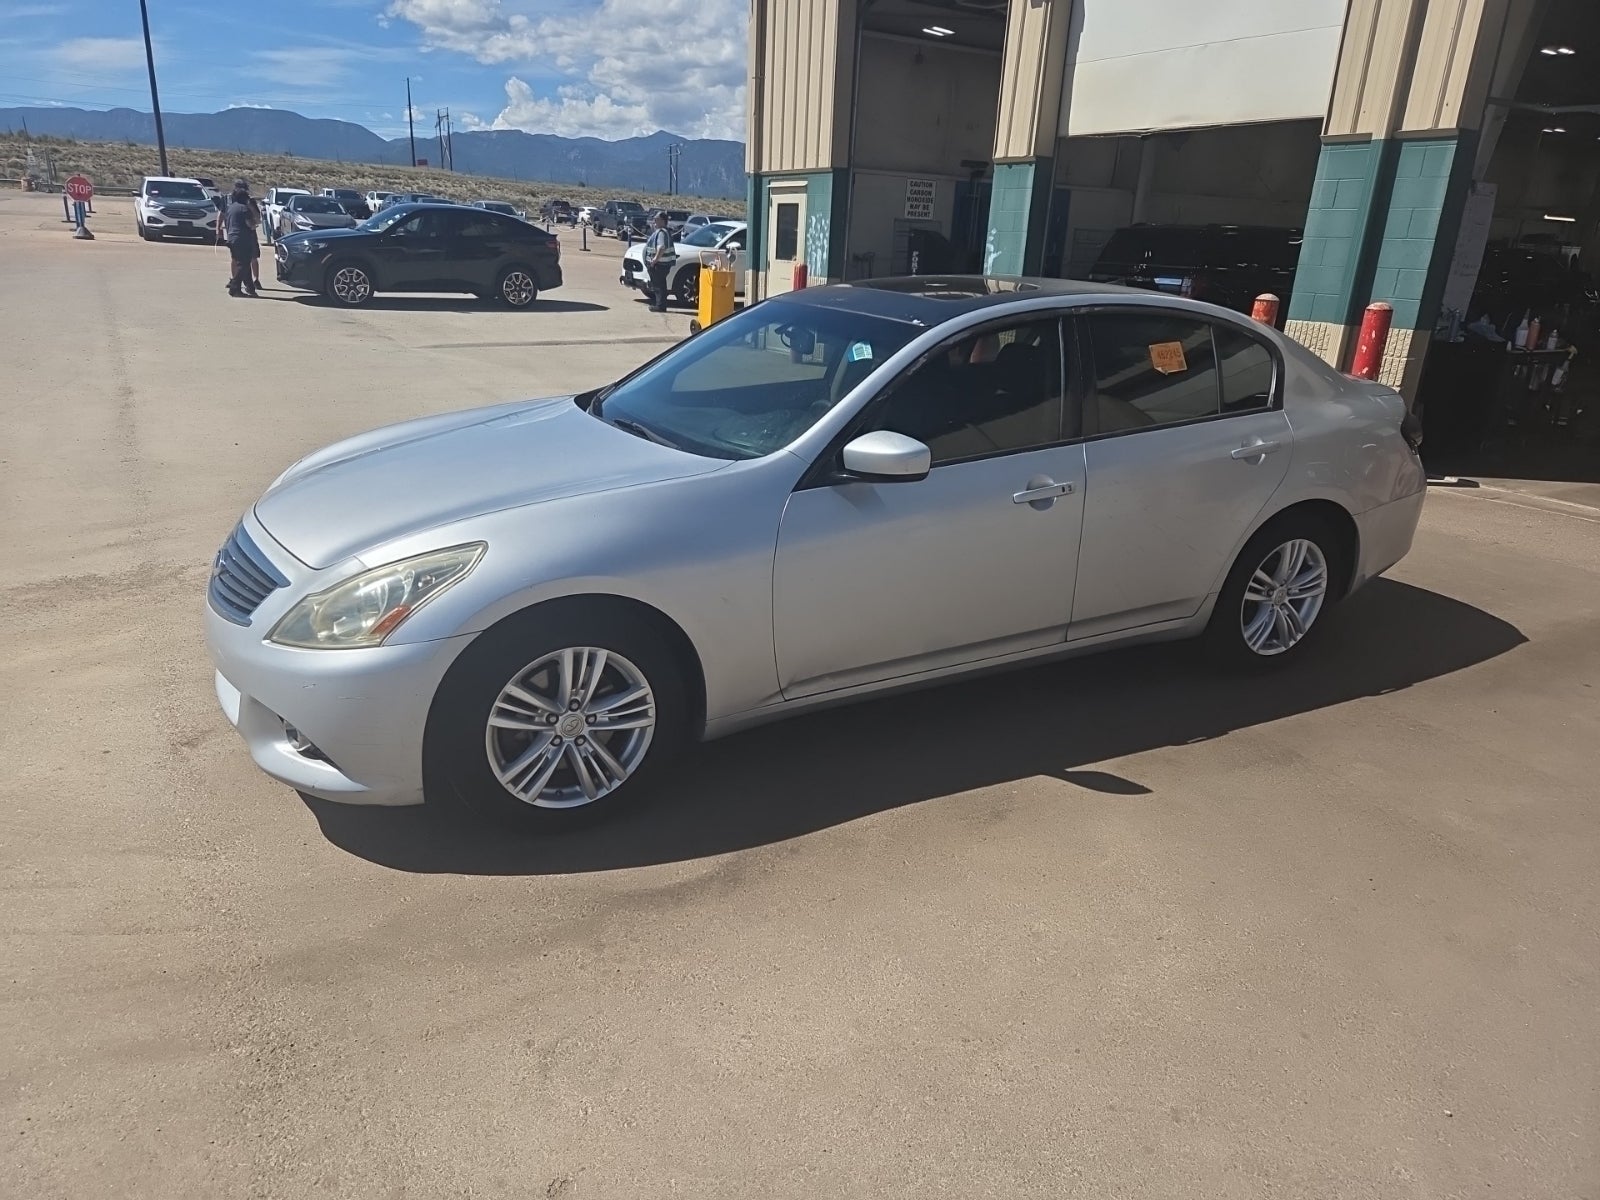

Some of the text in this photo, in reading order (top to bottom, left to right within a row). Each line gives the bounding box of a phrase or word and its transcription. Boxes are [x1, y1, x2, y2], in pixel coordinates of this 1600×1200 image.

[910, 180, 933, 188] CAUTION
[67, 183, 92, 194] STOP
[910, 189, 932, 197] CARBON
[906, 196, 934, 204] MONOXIDE
[907, 210, 930, 218] PRESENT
